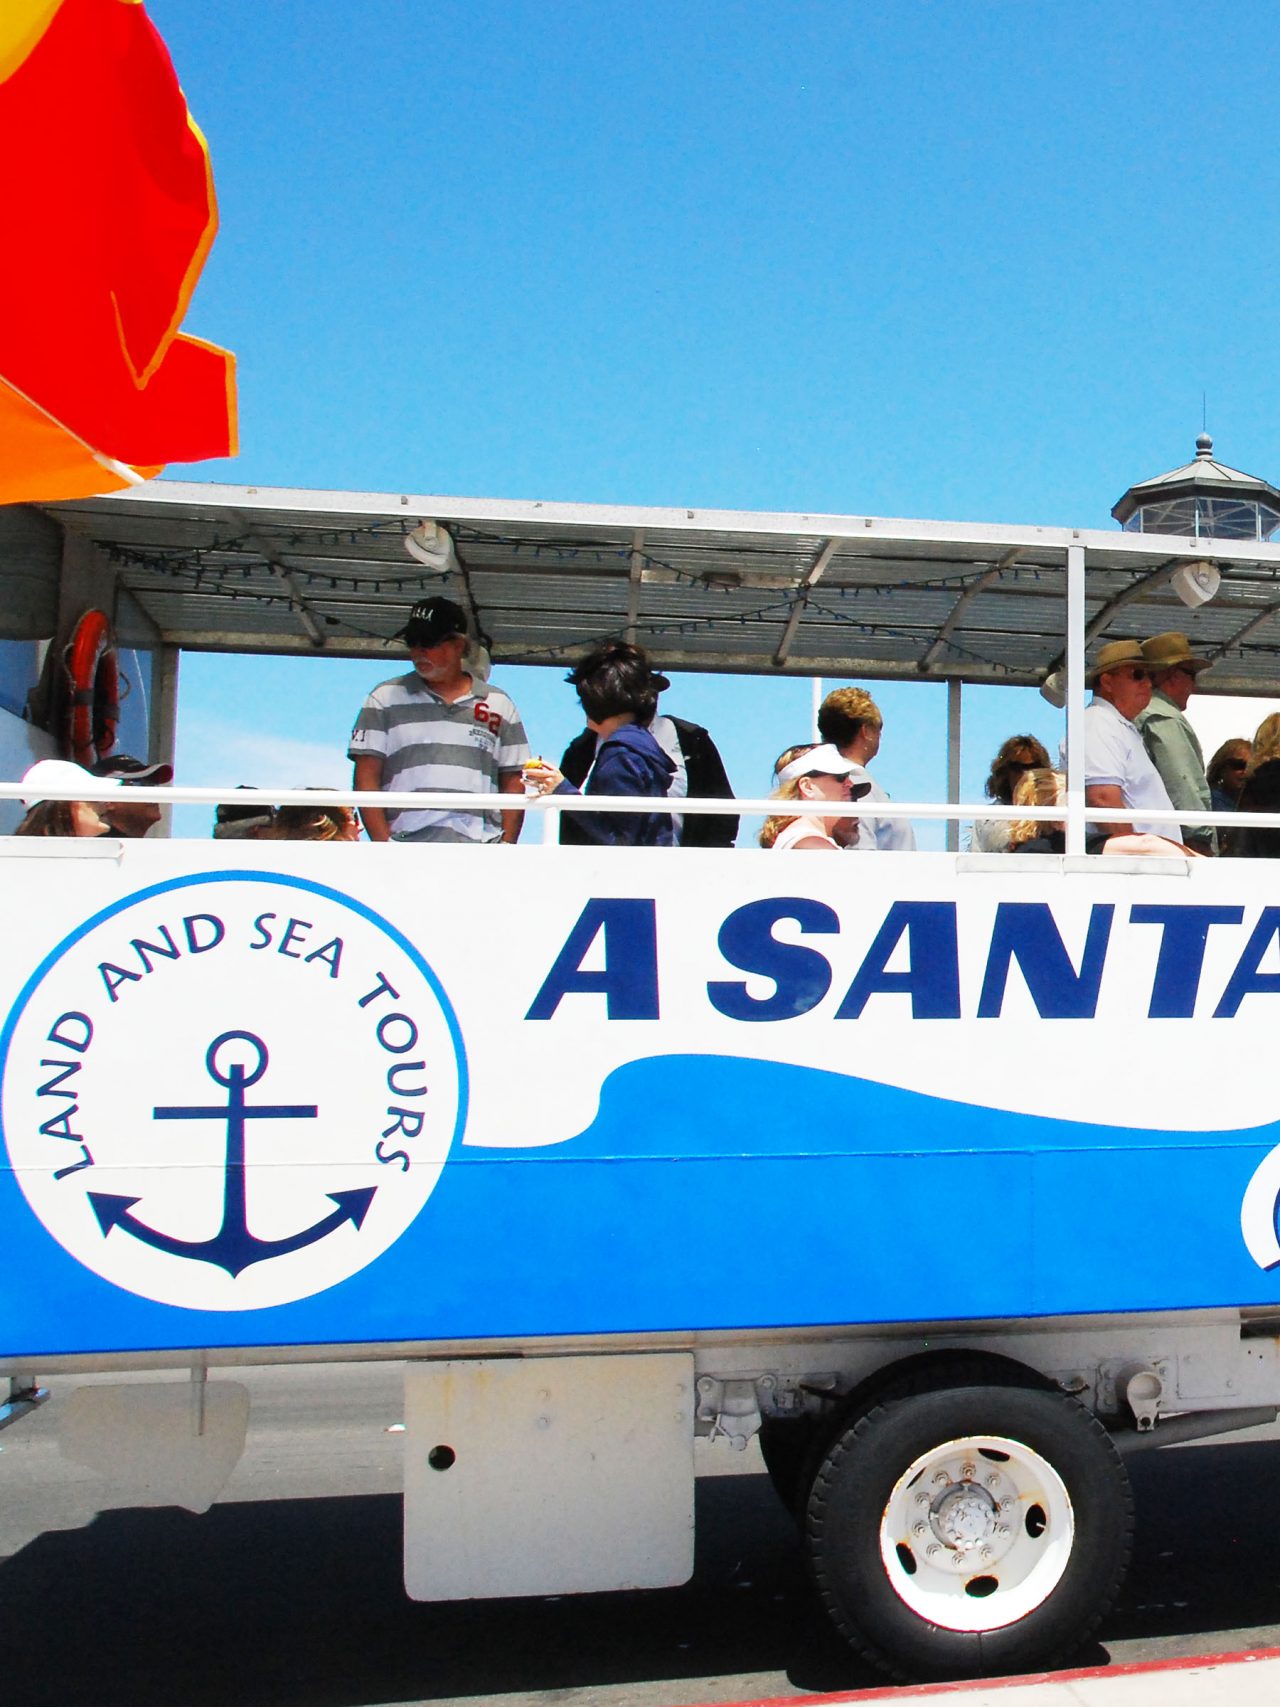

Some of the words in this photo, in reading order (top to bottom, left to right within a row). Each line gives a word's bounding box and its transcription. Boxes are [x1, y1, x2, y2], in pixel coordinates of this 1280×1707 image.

[36, 1010, 95, 1180] LAND
[97, 913, 225, 1002] AND
[249, 912, 344, 979] SEA
[358, 971, 428, 1172] TOURS
[524, 897, 660, 1020] A
